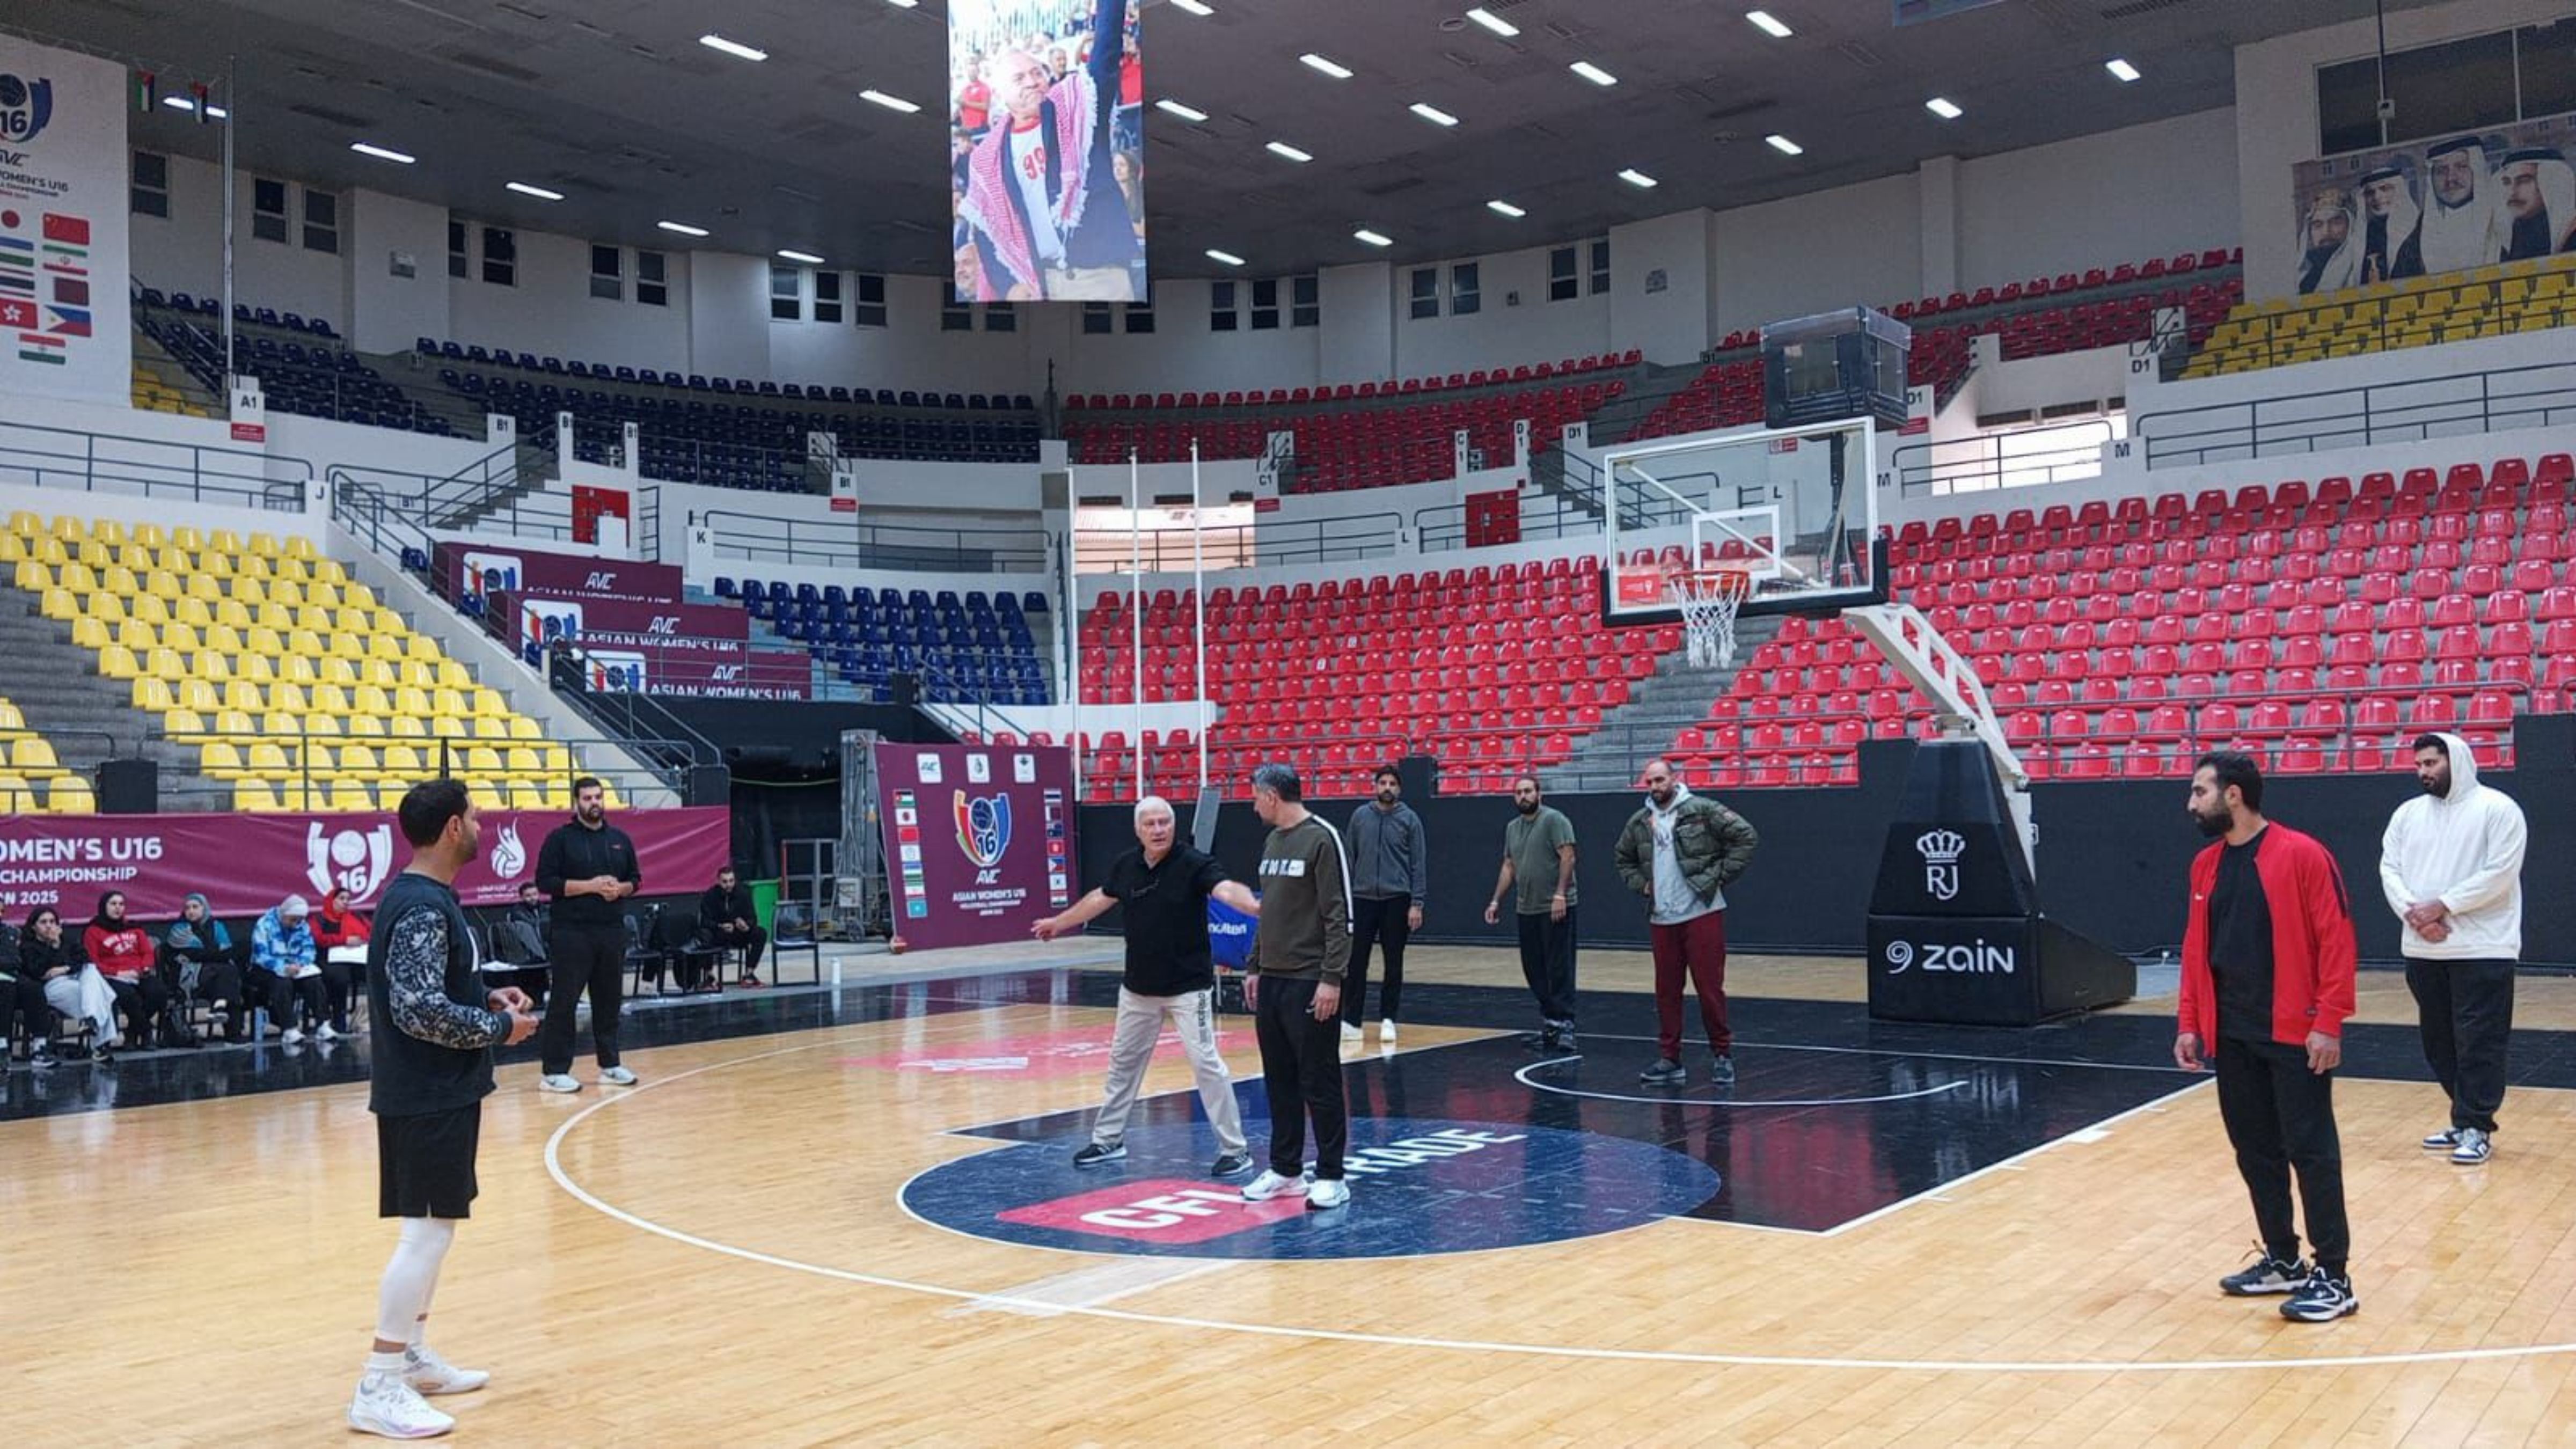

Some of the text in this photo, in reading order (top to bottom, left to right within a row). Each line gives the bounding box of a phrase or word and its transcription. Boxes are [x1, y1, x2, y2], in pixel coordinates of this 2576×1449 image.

[2132, 359, 2149, 373] D1
[240, 394, 257, 409] A1
[497, 419, 508, 431] B1
[1569, 427, 1581, 439] D1
[2116, 443, 2130, 458] M
[840, 477, 851, 488] B1
[1259, 474, 1272, 486] C1
[1877, 472, 1890, 487] M
[316, 485, 324, 500] J
[1774, 486, 1783, 499] L
[697, 531, 706, 544] K
[1402, 531, 1409, 543] L
[584, 572, 617, 590] AVC
[648, 616, 680, 634] AVC
[650, 683, 698, 696] ASIAN
[111, 837, 163, 860] U16
[977, 832, 997, 857] 16
[0, 866, 138, 884] CHAMPIONSHIP
[336, 865, 368, 894] 16
[975, 868, 1001, 885] AVC
[1926, 865, 1959, 901] RJ
[20, 890, 60, 905] 2025
